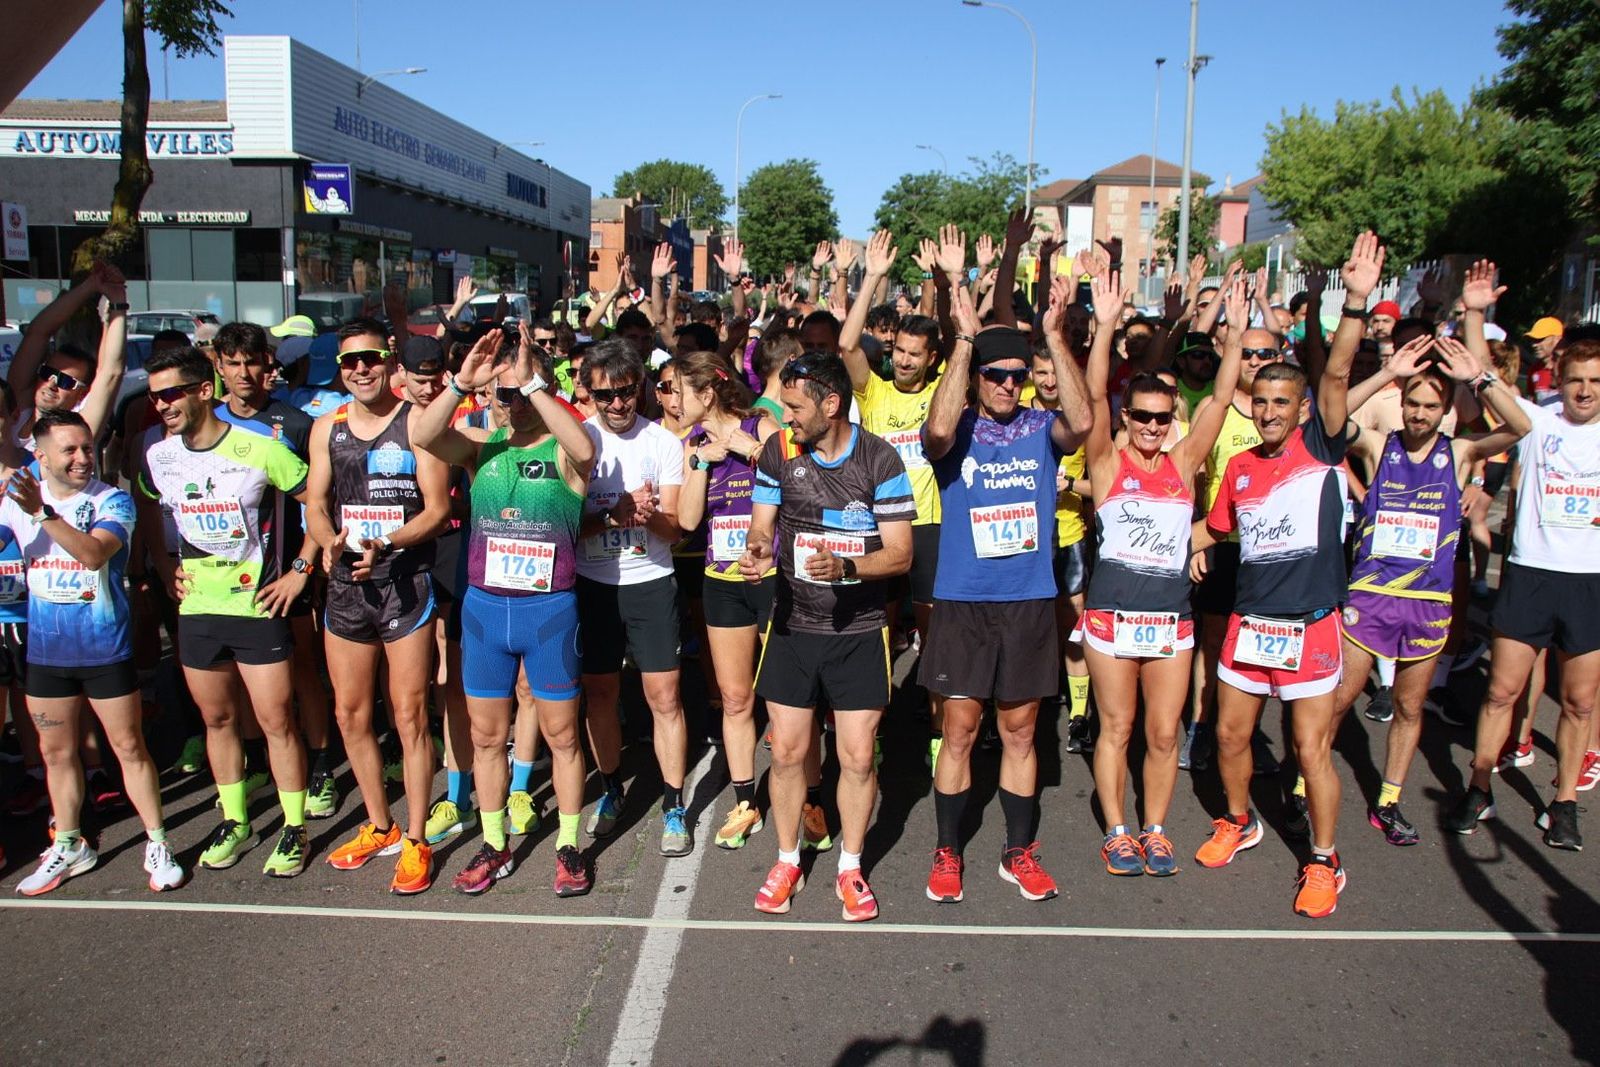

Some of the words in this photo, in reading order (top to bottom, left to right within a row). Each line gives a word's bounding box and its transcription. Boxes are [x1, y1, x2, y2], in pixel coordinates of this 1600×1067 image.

[15, 131, 234, 155] AUTOMVILES
[74, 210, 112, 223] MECAN
[177, 211, 248, 223] ELECTRICIDAD
[880, 434, 922, 444] edun
[979, 456, 1039, 479] apaches
[728, 479, 750, 488] PRIM
[983, 473, 1036, 490] running
[1545, 484, 1600, 497] beduni
[1417, 491, 1443, 500] PRIM
[180, 501, 239, 514] bedunia
[1564, 496, 1590, 514] 82
[196, 513, 229, 532] 106
[343, 508, 403, 521] bedunia
[973, 506, 1035, 524] bedunia
[1117, 500, 1156, 529] Simón
[1377, 513, 1437, 529] bedunia
[361, 521, 382, 540] 30
[713, 518, 752, 530] bedun
[989, 520, 1022, 543] 141
[599, 529, 631, 548] 131
[727, 530, 746, 548] 69
[1394, 526, 1417, 545] 78
[488, 541, 553, 559] bedunia
[31, 558, 88, 571] bedun
[501, 555, 537, 577] 176
[45, 571, 82, 590] 144
[1116, 614, 1176, 626] eduni
[1134, 626, 1156, 643] 60
[1255, 633, 1288, 655] 127
